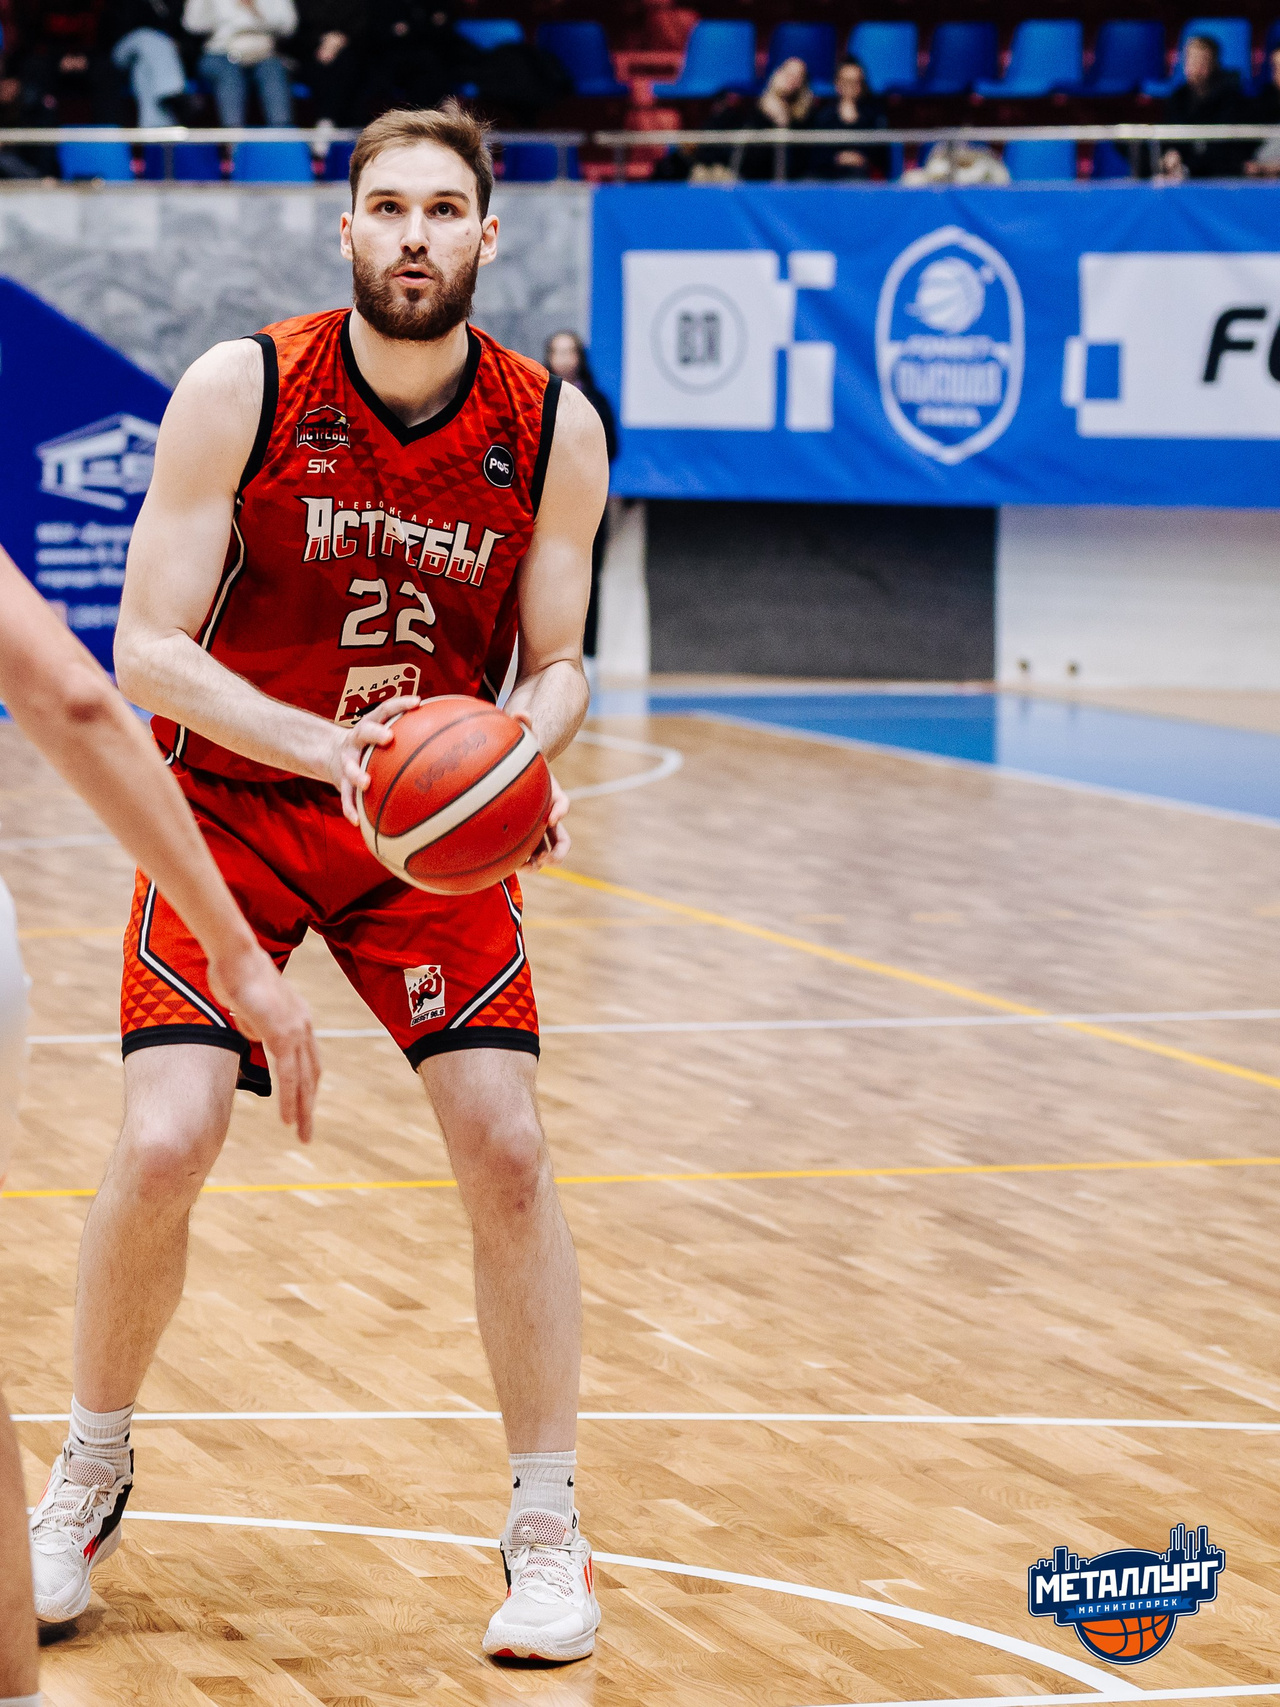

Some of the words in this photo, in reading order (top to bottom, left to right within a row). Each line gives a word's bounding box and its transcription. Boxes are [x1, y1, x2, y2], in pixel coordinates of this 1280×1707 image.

[1202, 306, 1280, 384] F
[297, 497, 506, 588] ЯСТРЕБЫ
[338, 500, 452, 530] ЧЕБОКСАРЫ
[339, 578, 437, 654] 22
[346, 674, 401, 695] РАДИО
